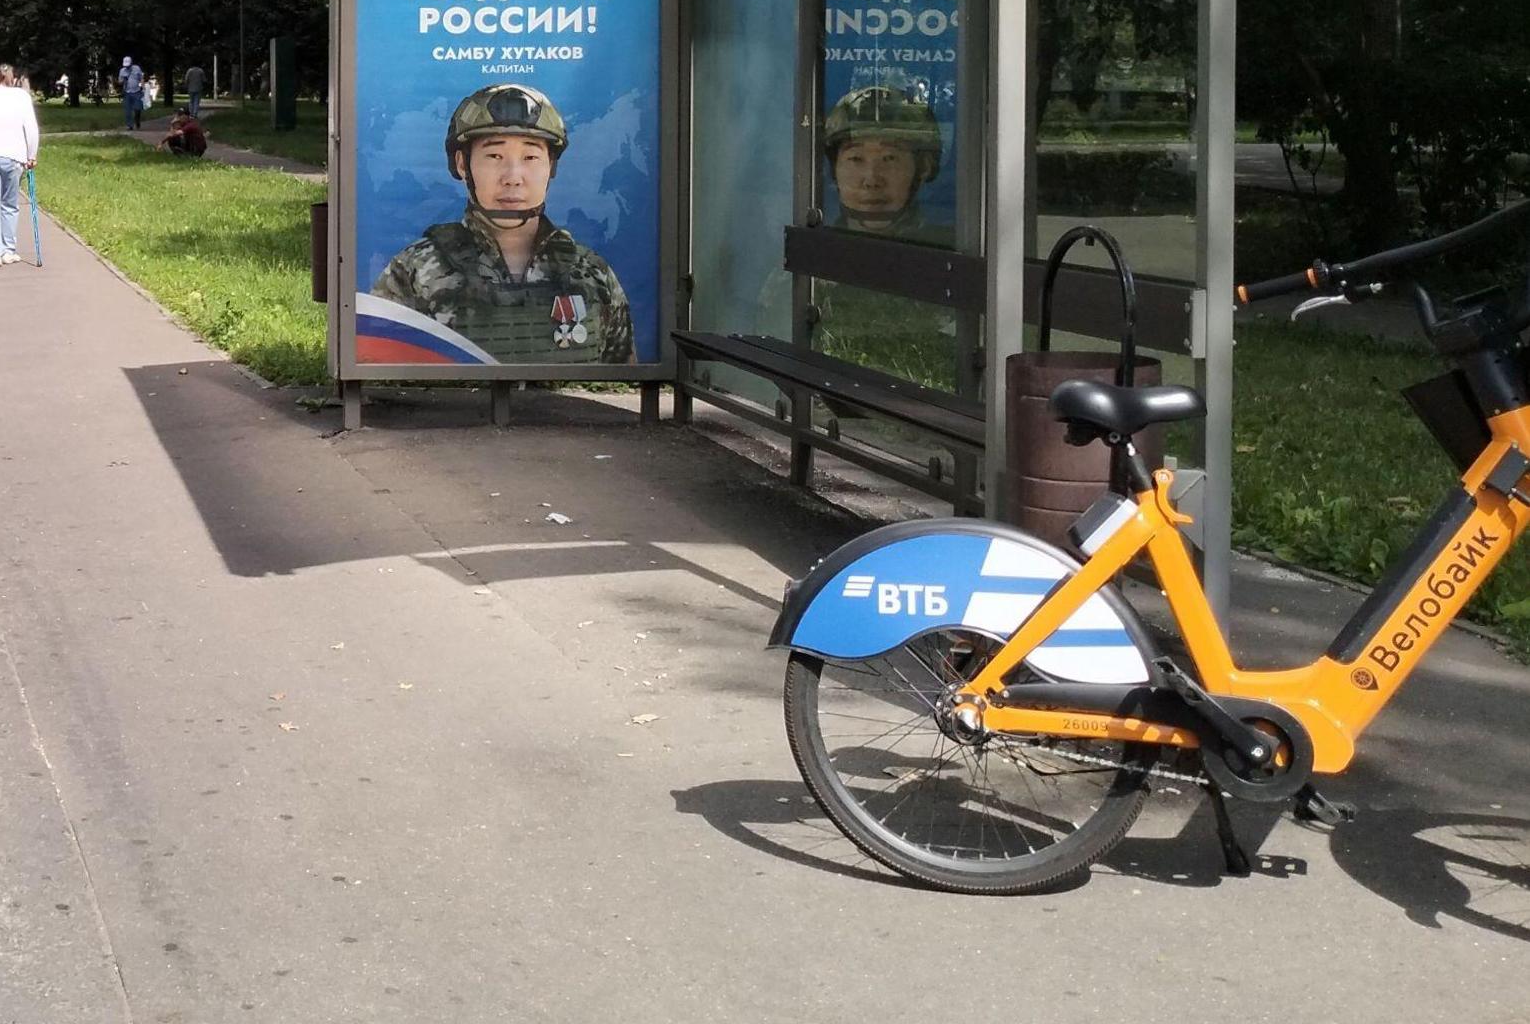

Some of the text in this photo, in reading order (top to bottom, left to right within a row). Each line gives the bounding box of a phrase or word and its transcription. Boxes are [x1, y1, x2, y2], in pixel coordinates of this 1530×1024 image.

[419, 6, 598, 34] РОССИИ!
[432, 46, 584, 61] САМБУ ХУТАКОВ
[481, 64, 534, 74] КАПИТАН
[878, 583, 948, 616] ВТБ
[1368, 526, 1500, 672] Велобайк
